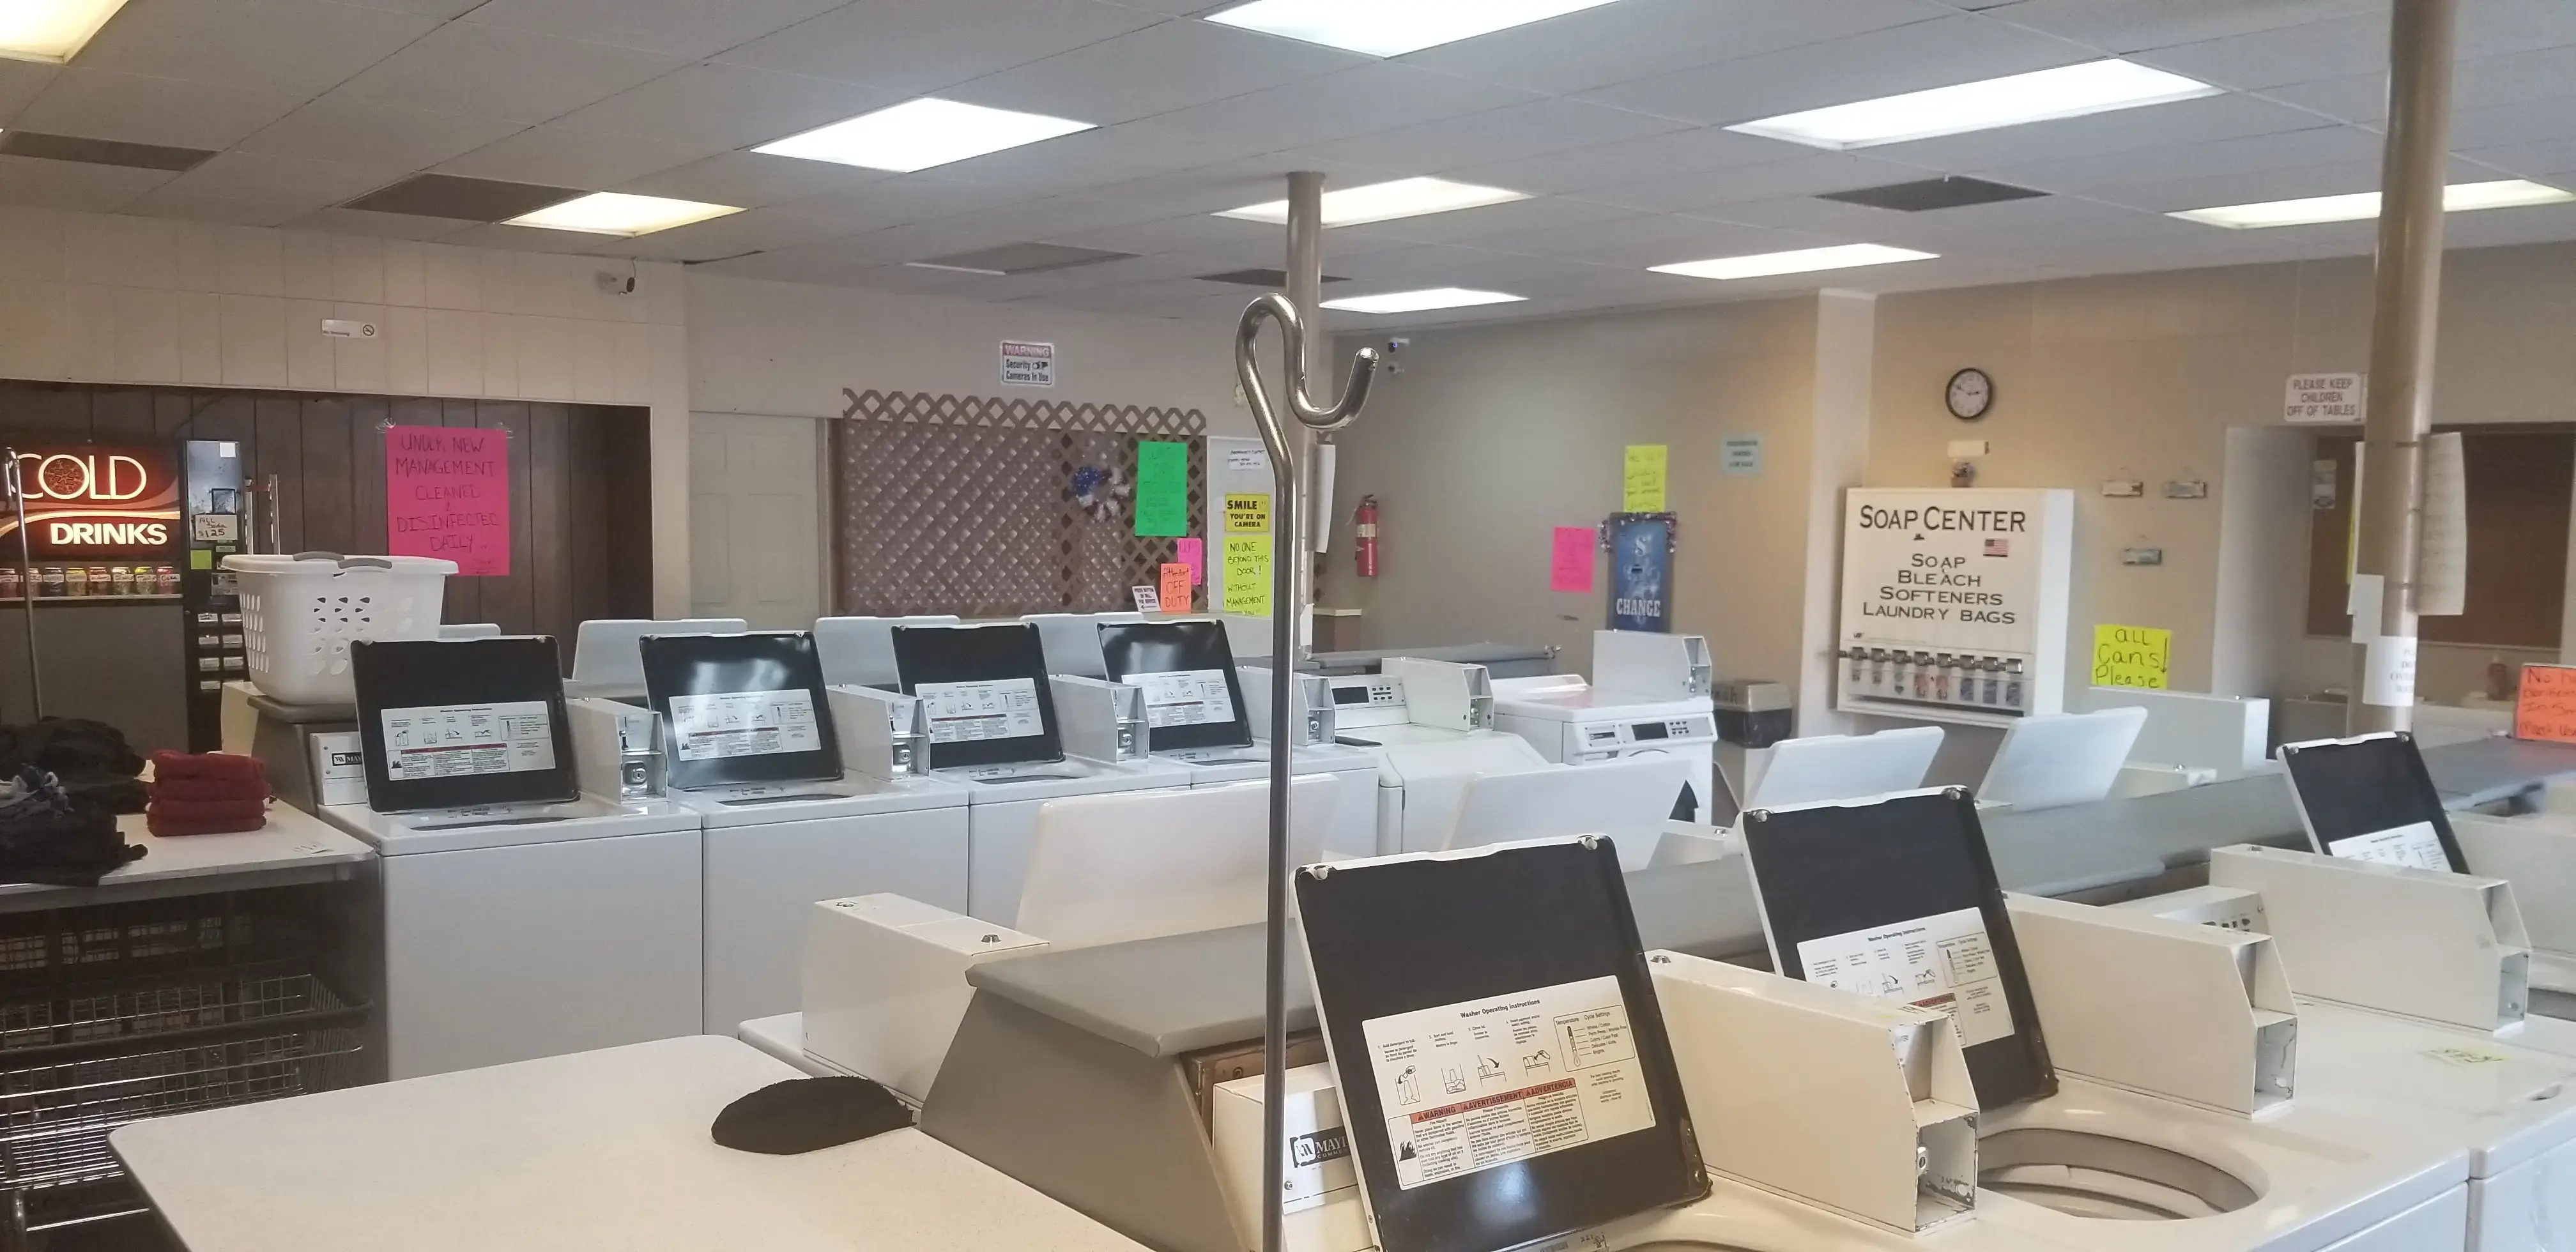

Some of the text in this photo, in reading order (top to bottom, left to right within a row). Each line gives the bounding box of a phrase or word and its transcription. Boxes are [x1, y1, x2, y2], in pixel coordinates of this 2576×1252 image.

[1004, 344, 1050, 357] WARNING
[1006, 358, 1031, 371] Security
[1006, 370, 1031, 381] Cameras
[2293, 378, 2353, 390] PLEASE KEEP
[2301, 392, 2343, 403] CHILDREN
[2287, 405, 2356, 416] OFF OF TABLES
[401, 434, 486, 453] UNDER NEW
[395, 457, 495, 478] MANAGEMENT
[9, 453, 147, 500] COLD
[415, 485, 480, 500] CLEANED
[1227, 500, 1257, 510] SMILE
[397, 513, 498, 533] DISINFECTED
[1860, 505, 2026, 532] SOAP CENTER
[50, 523, 167, 545] DRINKS
[429, 535, 473, 553] DAILY
[1229, 542, 1257, 553] NO ONE
[1227, 554, 1269, 565] BEYOND THIS
[1911, 553, 1966, 569] SOAP
[1236, 567, 1256, 576] DOOR
[1897, 570, 1981, 587] BLEACH
[1166, 580, 1184, 594] OFF
[1227, 583, 1257, 592] WITHOUT
[1165, 595, 1189, 607] DUTY
[1226, 595, 1266, 607] MANAGEMENT
[1880, 586, 2004, 606] SOFTENERS
[1616, 598, 1661, 618] CHANGE
[1862, 602, 2016, 624] LAUNDRY BAGS
[2098, 643, 2159, 669] Cans
[2095, 664, 2161, 689] Please
[1460, 998, 1540, 1018] Washer Operating Instructions
[1595, 1010, 1610, 1019] Settings
[1530, 1080, 1572, 1095] ADVERTENCIA
[1468, 1090, 1522, 1109] AVERTISSEMENT
[1423, 1106, 1456, 1119] WARNING
